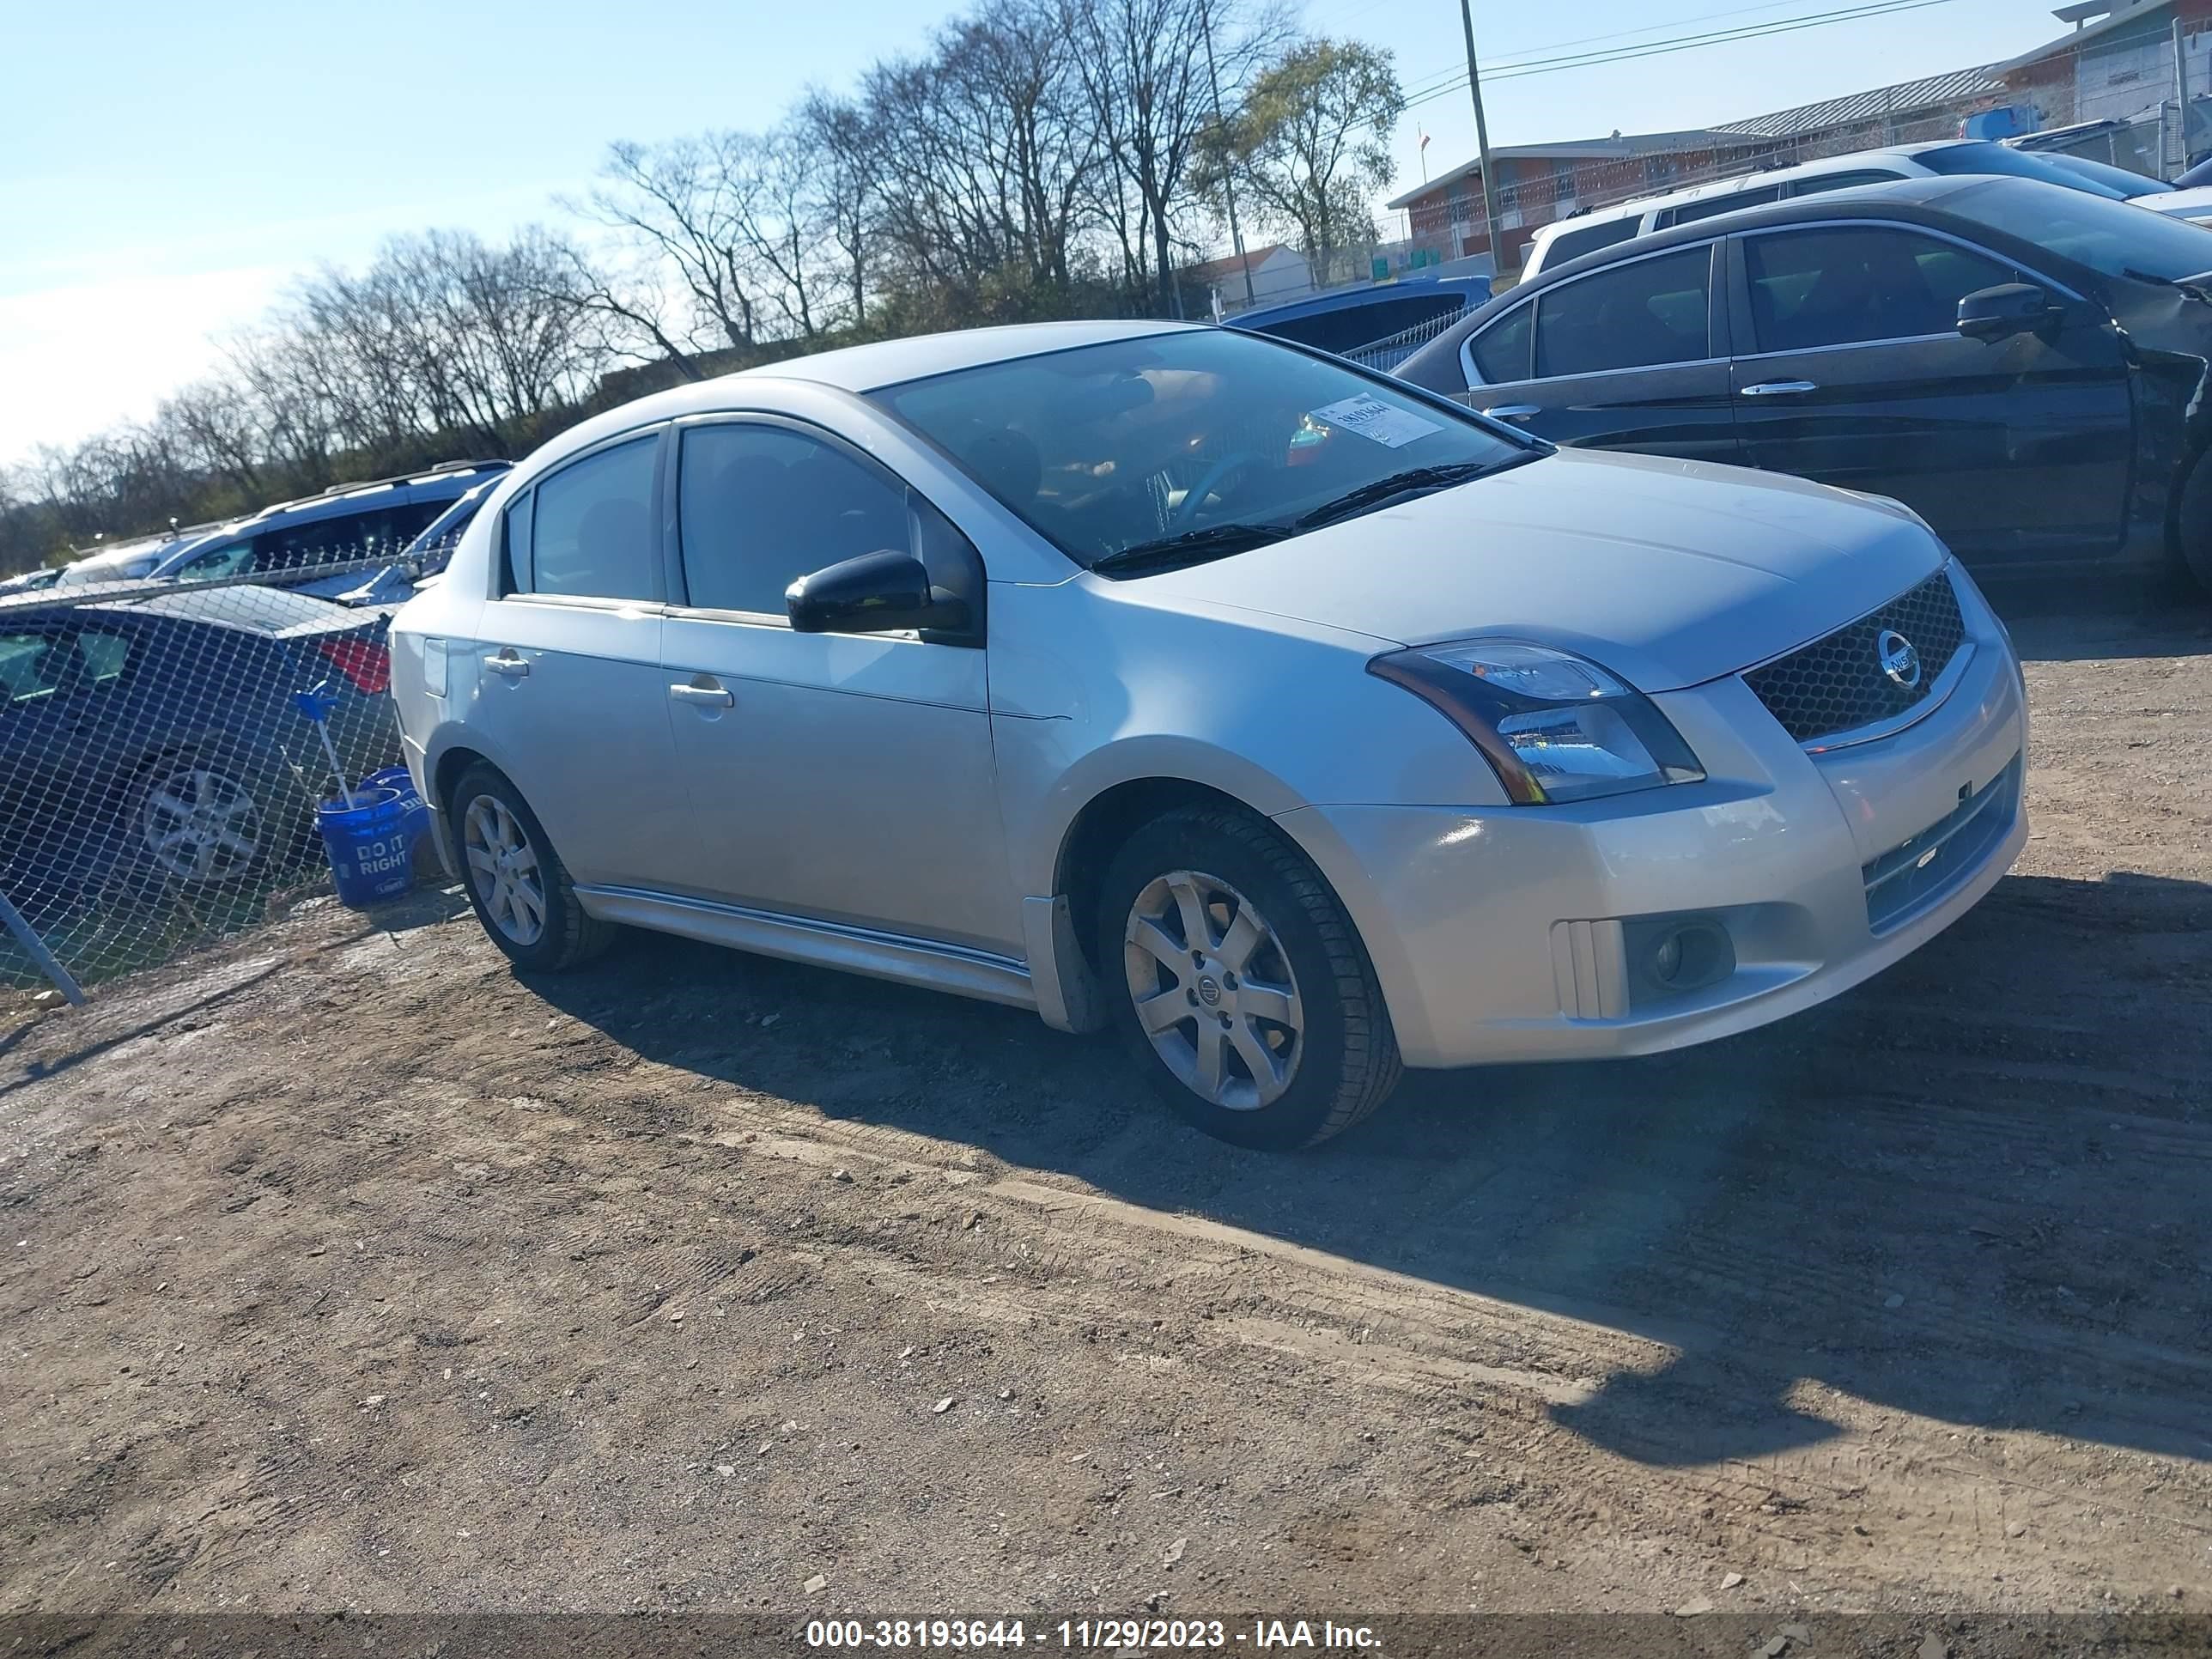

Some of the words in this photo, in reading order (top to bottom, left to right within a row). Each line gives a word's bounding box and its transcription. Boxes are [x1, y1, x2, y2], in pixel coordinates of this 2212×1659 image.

[1337, 404, 1391, 422] 38193644
[356, 842, 386, 860] DO
[391, 835, 404, 852] IT
[359, 851, 406, 875] RIGHT
